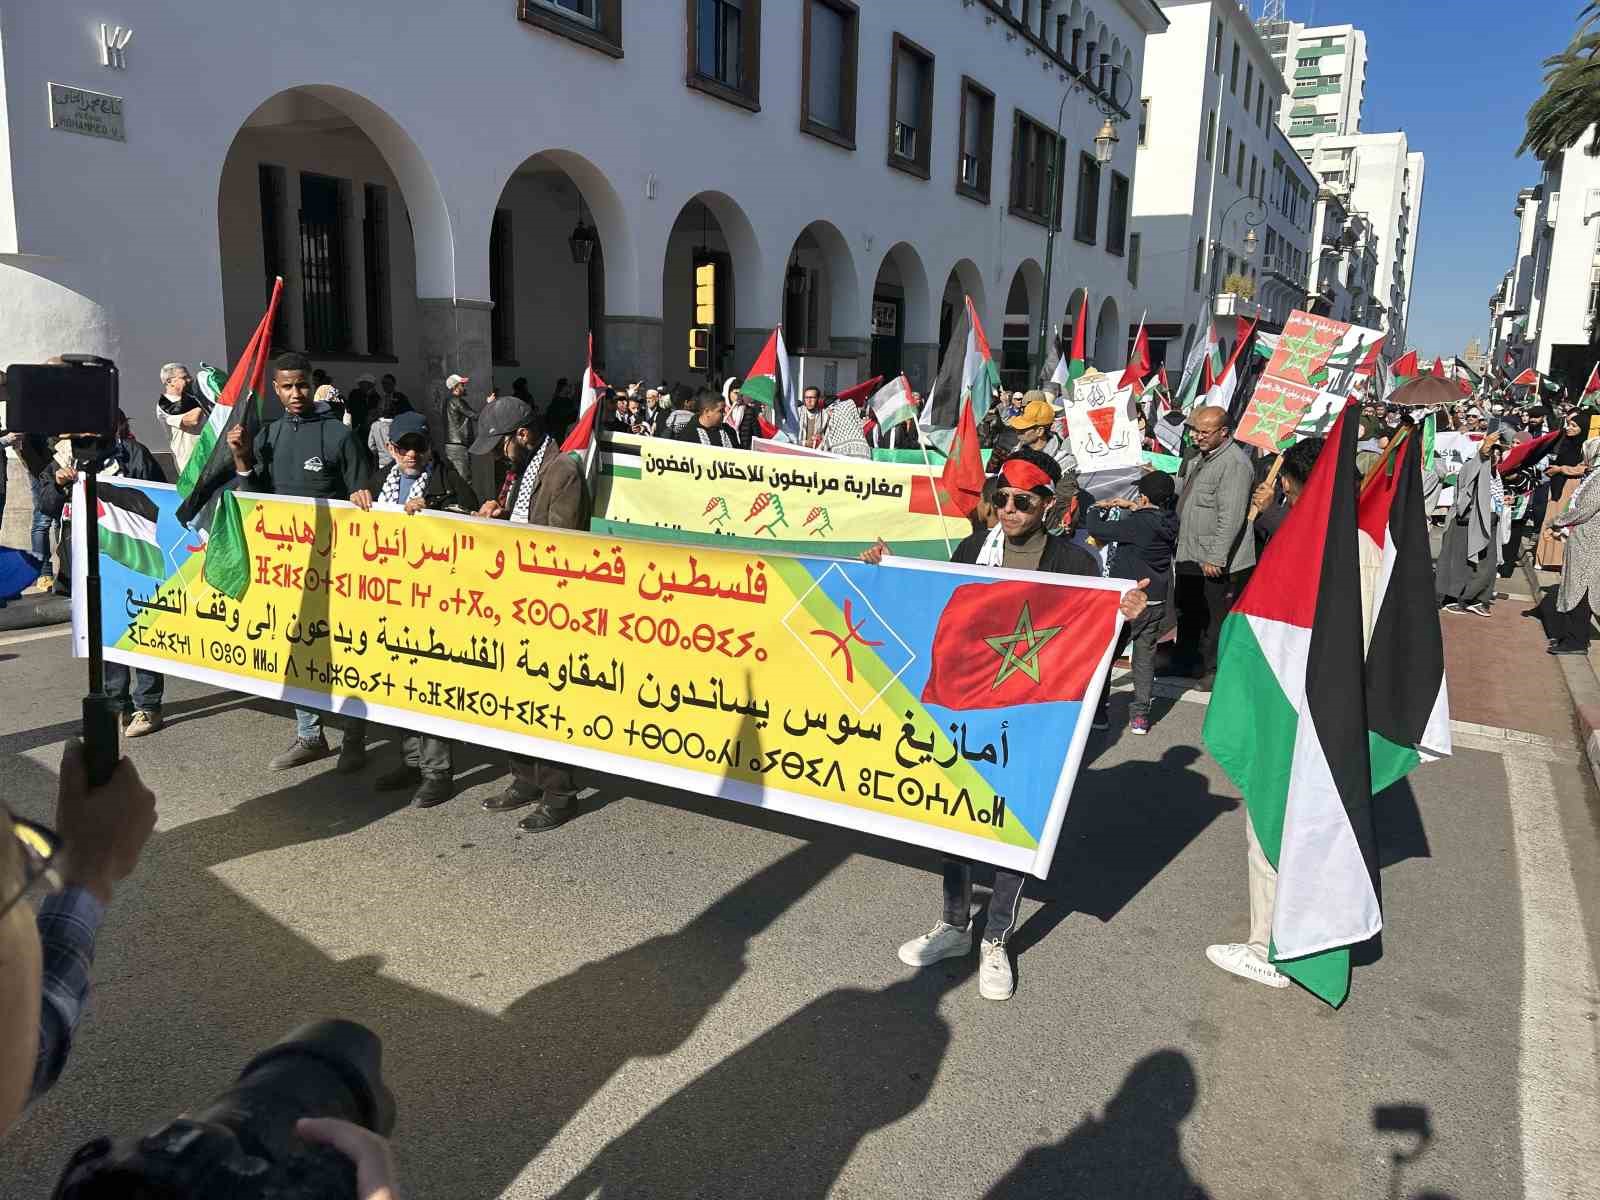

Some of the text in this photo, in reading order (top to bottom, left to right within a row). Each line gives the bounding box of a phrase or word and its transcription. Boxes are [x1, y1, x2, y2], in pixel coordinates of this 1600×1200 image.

[645, 453, 903, 500] مغاربة مرابطون للاحتلال رافضون
[255, 504, 338, 558] إرهابية
[485, 549, 505, 578] و
[516, 540, 626, 589] قضيتنا
[638, 554, 768, 604] فلسطين
[125, 583, 1010, 769] أمازيغ سوس يساندون المقاومة الفلسطينية ويدعون إلى وقف التطبيع
